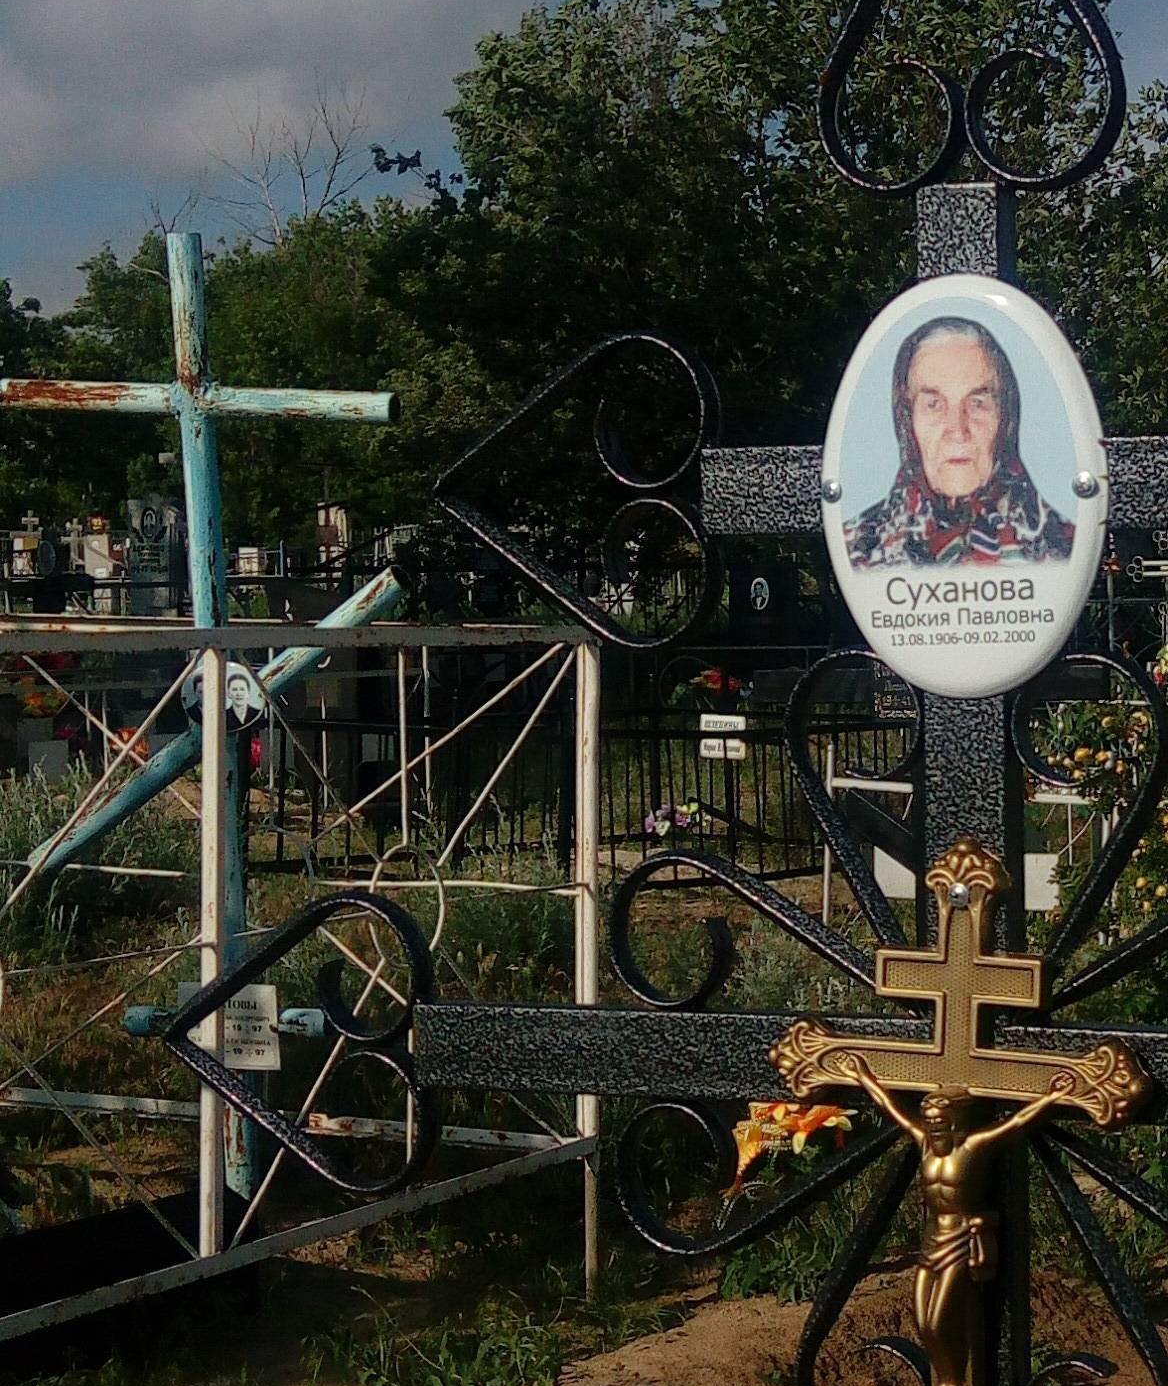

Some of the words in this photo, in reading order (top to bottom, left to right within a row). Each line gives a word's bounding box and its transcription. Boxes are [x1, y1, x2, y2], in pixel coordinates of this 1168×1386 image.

[886, 577, 1035, 611] Суханова
[871, 610, 950, 630] Евдокия
[957, 607, 1055, 626] Павловна
[891, 629, 1036, 647] 13.08.1906-09.02.2000
